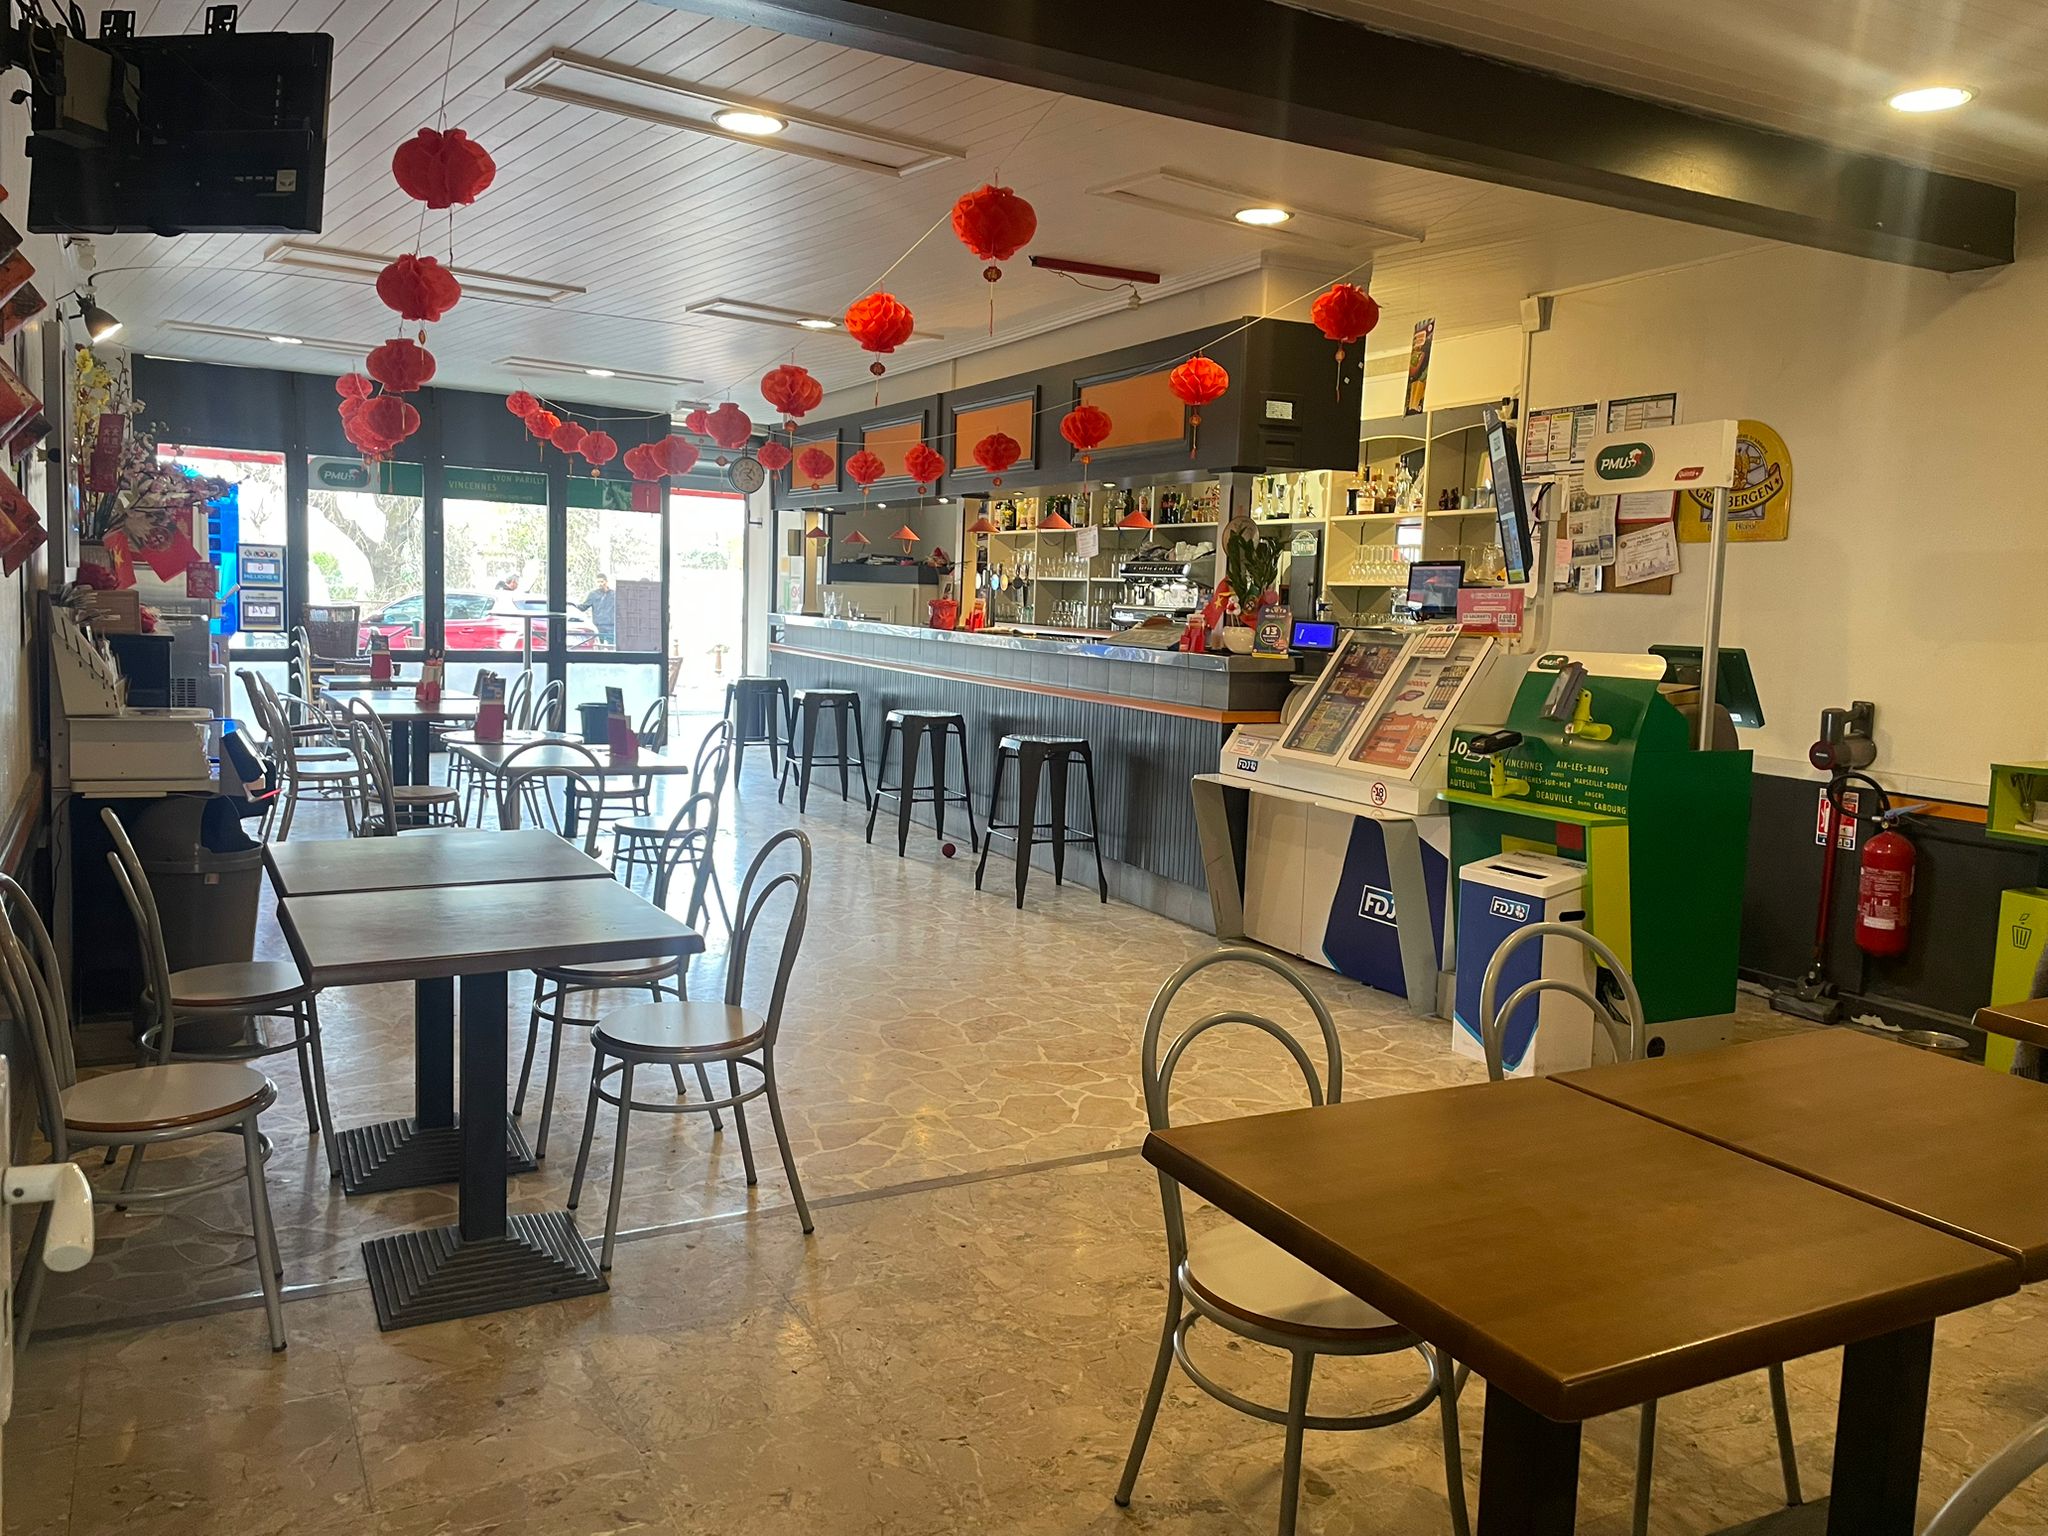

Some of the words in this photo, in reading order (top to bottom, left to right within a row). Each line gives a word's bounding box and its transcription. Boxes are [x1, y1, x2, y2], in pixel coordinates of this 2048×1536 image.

[1600, 456, 1628, 472] PMU
[324, 470, 348, 481] PMU
[492, 474, 513, 483] LYON
[515, 475, 545, 485] PARILLY
[448, 480, 497, 491] VINCENNES
[1695, 482, 1775, 508] GRIBERGEN
[1265, 626, 1277, 635] 13
[1556, 760, 1609, 775] AIX-LES-BAINS
[1450, 778, 1477, 790] AUTEUIL
[1536, 790, 1573, 804] DEAUVILLE
[1593, 802, 1627, 815] CABOURG
[1493, 900, 1514, 916] FDJ
